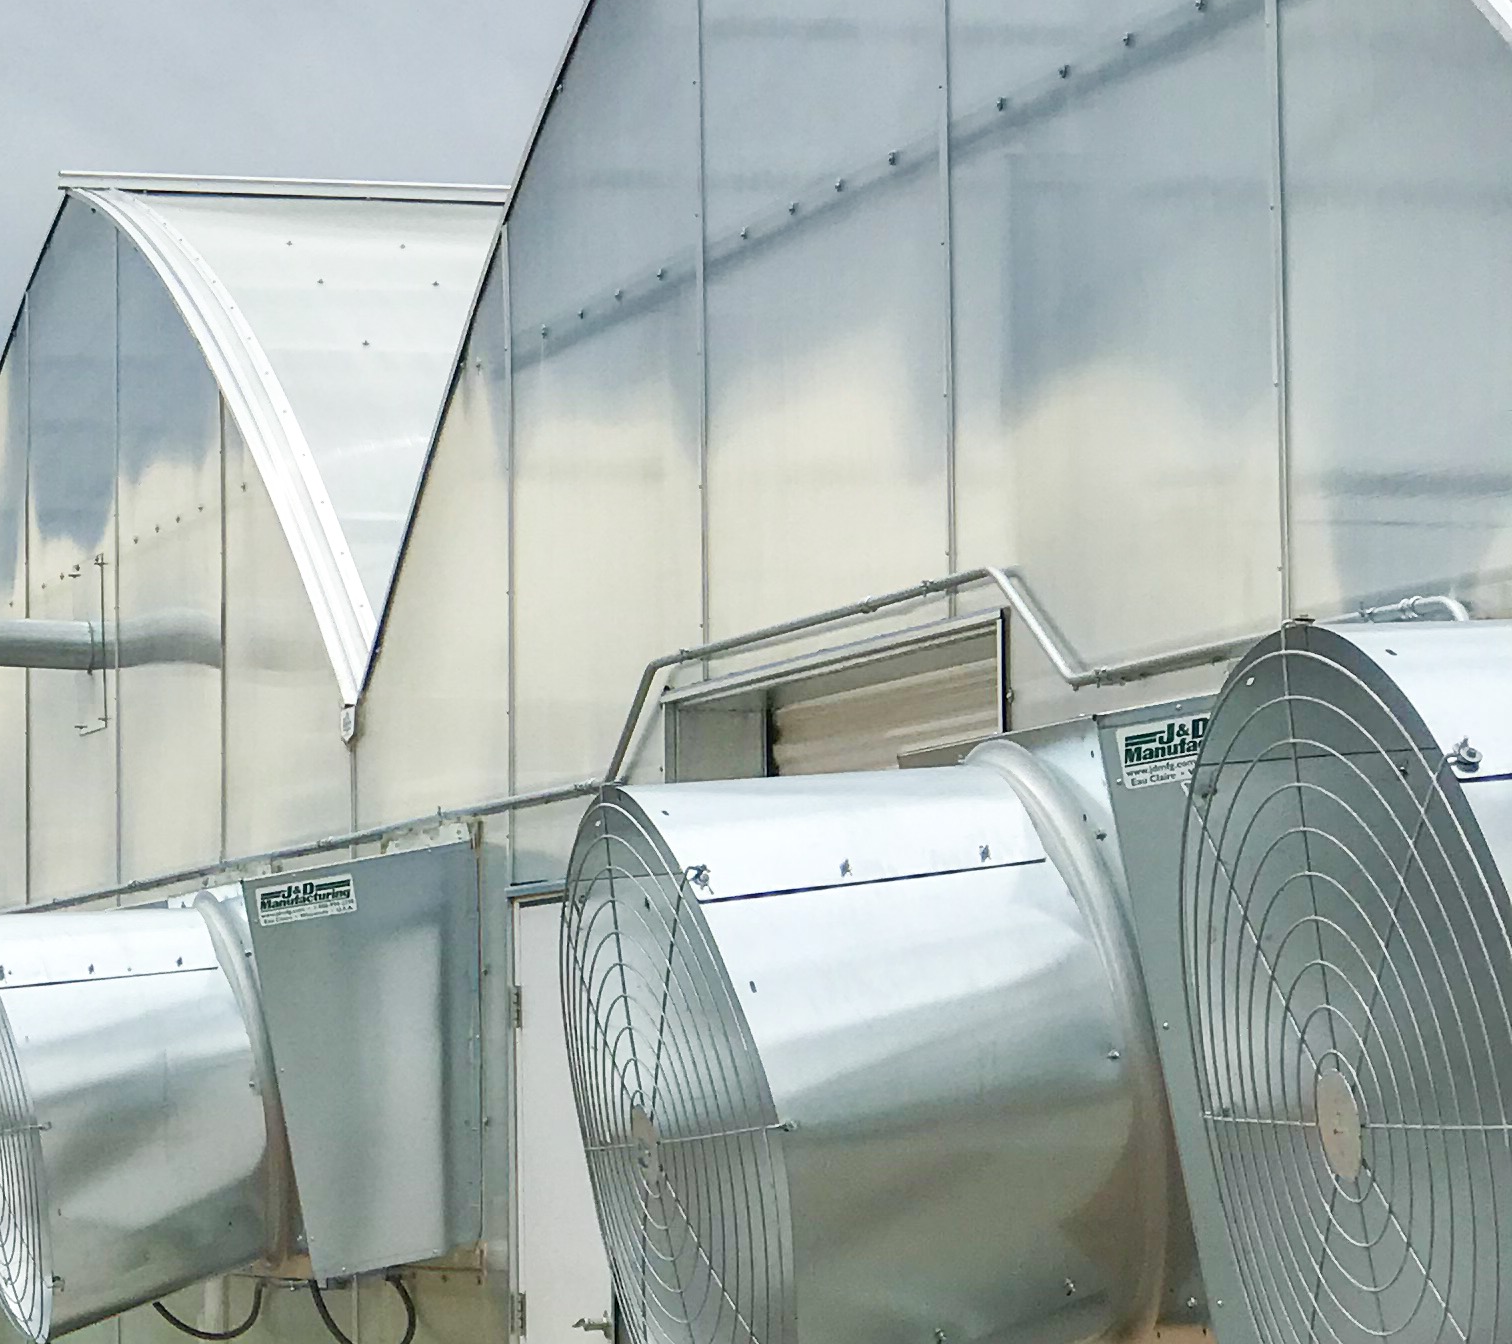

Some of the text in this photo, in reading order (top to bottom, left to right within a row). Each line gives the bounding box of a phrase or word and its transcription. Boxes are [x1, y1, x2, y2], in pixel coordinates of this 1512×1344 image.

[1158, 717, 1209, 745] J&D
[1149, 771, 1177, 783] Claire
[260, 888, 350, 910] Manufacturing
[281, 882, 314, 898] J&D
